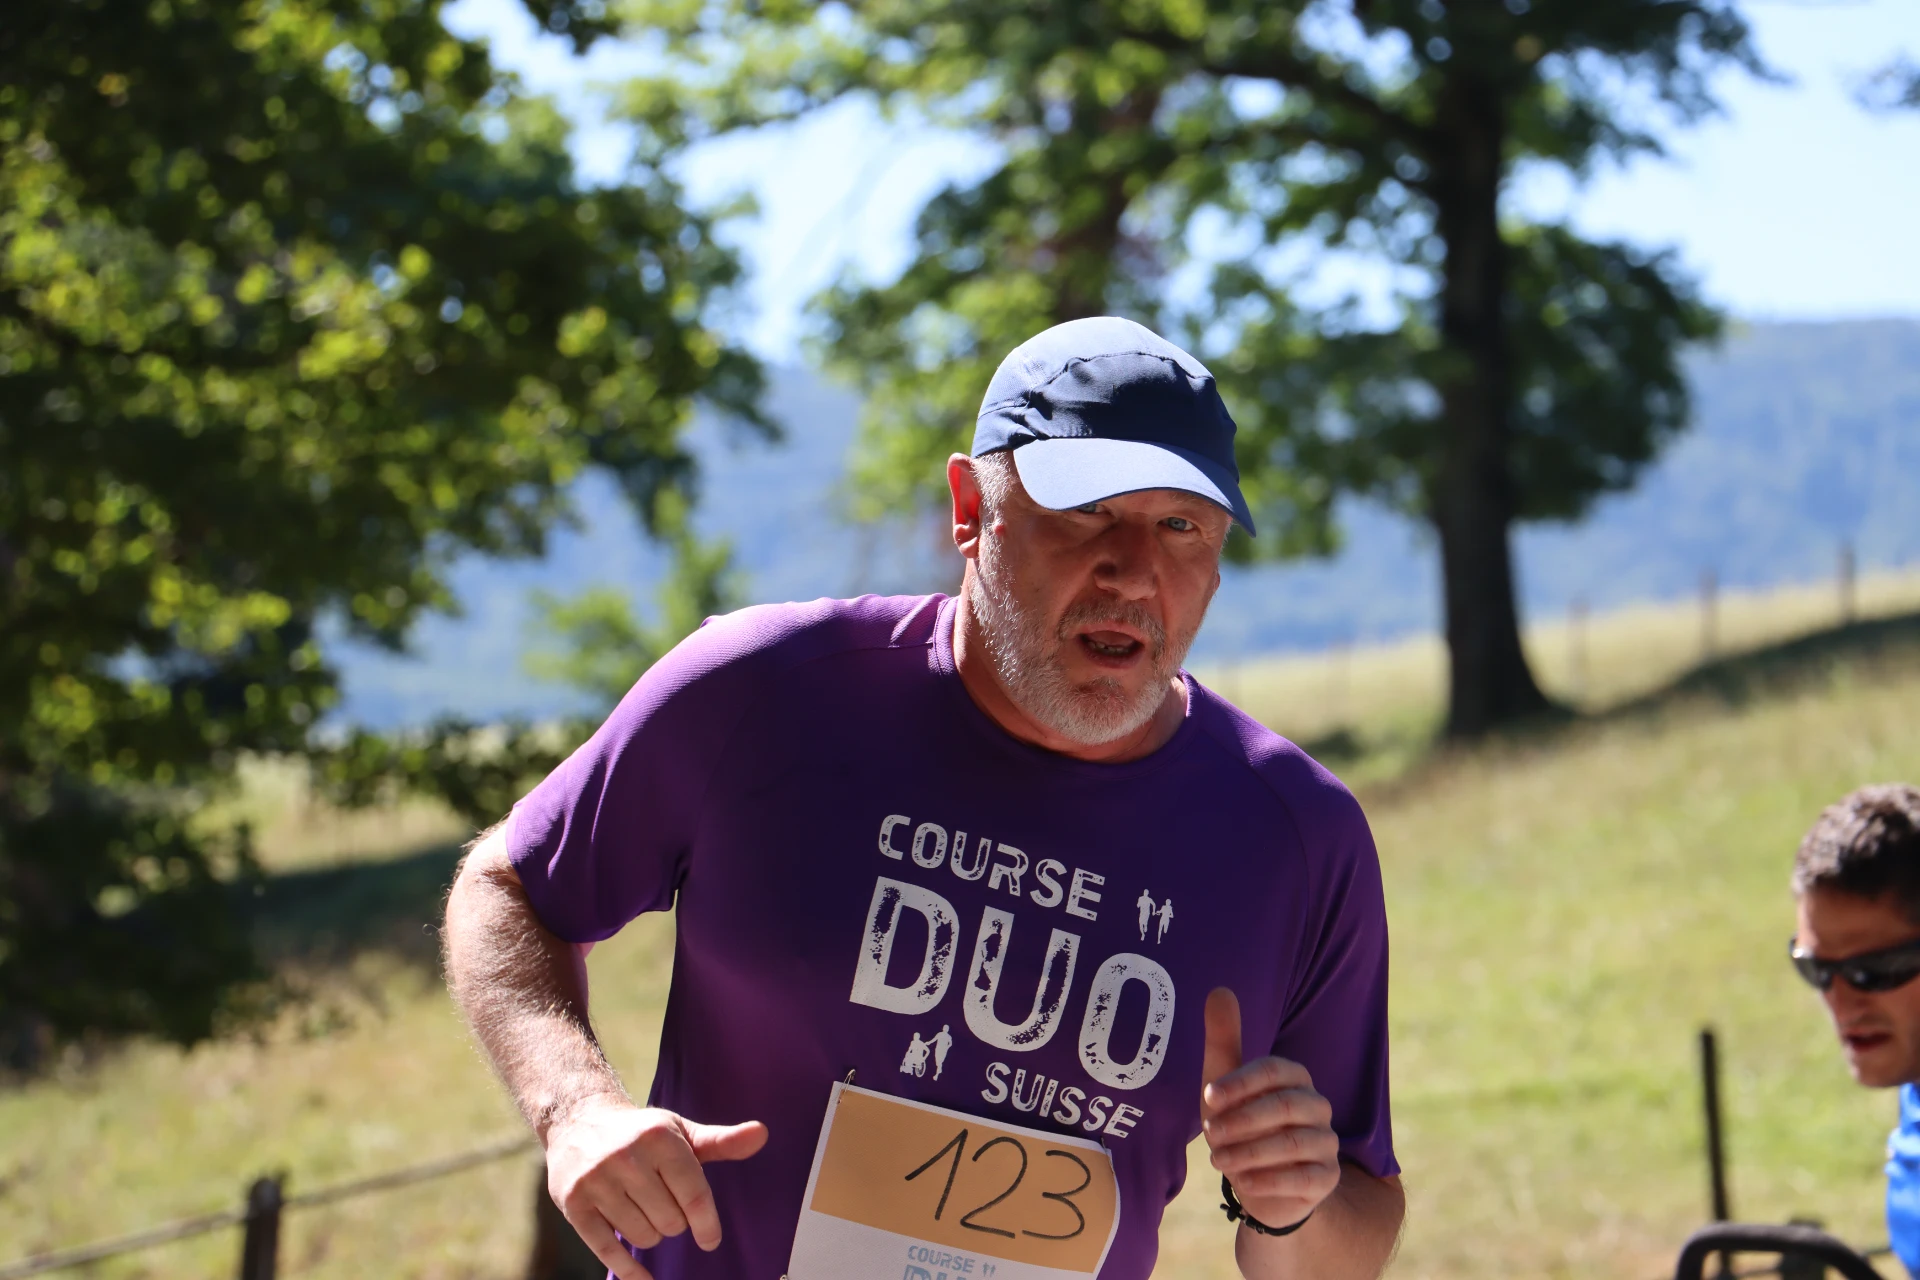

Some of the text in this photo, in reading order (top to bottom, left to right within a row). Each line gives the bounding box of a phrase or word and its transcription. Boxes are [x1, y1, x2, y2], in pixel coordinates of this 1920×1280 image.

[878, 814, 1105, 921] COURSE
[849, 876, 1176, 1090] DUO
[981, 1062, 1145, 1138] SUISSE
[904, 1129, 1092, 1240] 123
[907, 1245, 976, 1274] COURSE
